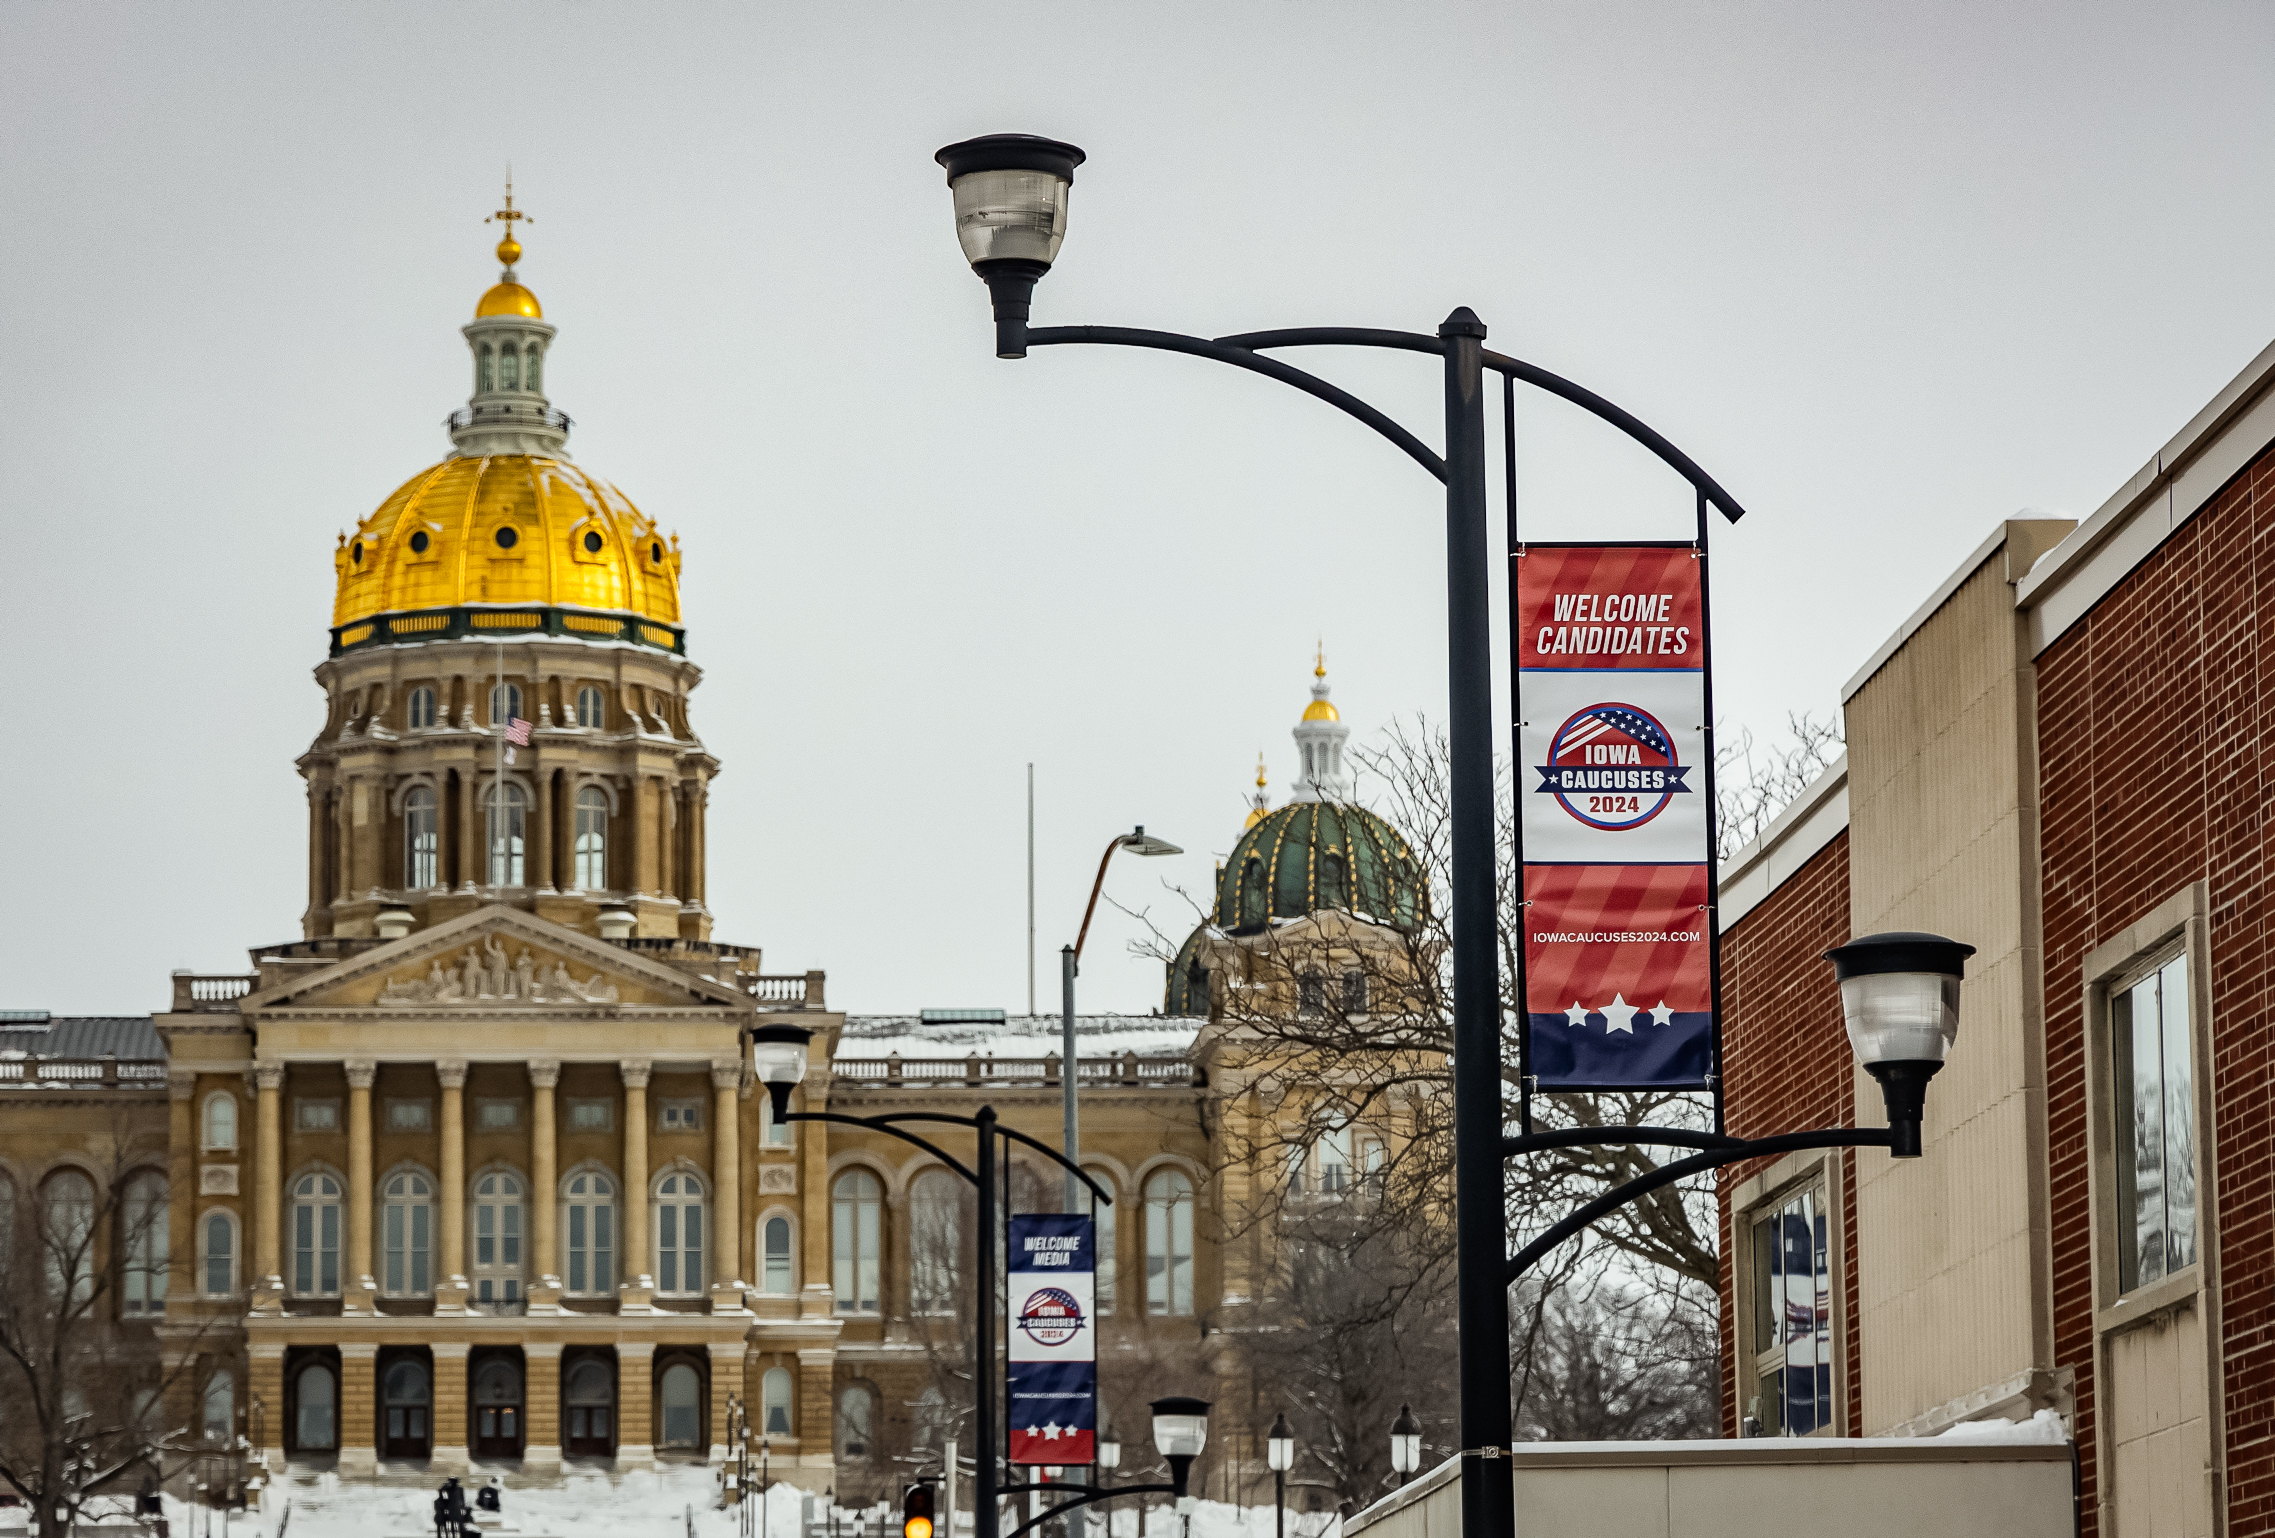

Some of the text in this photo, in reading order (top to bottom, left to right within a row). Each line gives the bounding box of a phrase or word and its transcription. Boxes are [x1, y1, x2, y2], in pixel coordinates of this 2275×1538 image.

[1553, 593, 1673, 622] WELCOME
[1536, 626, 1690, 655] CANDIDATES
[1585, 744, 1642, 765] IOWA
[1561, 770, 1665, 789] CAUCUSES
[1589, 796, 1640, 813] 2024
[1533, 931, 1700, 943] IOWACAUCUSES2024.COM
[1024, 1236, 1081, 1251] WELCOME
[1032, 1251, 1070, 1266] MEDIA
